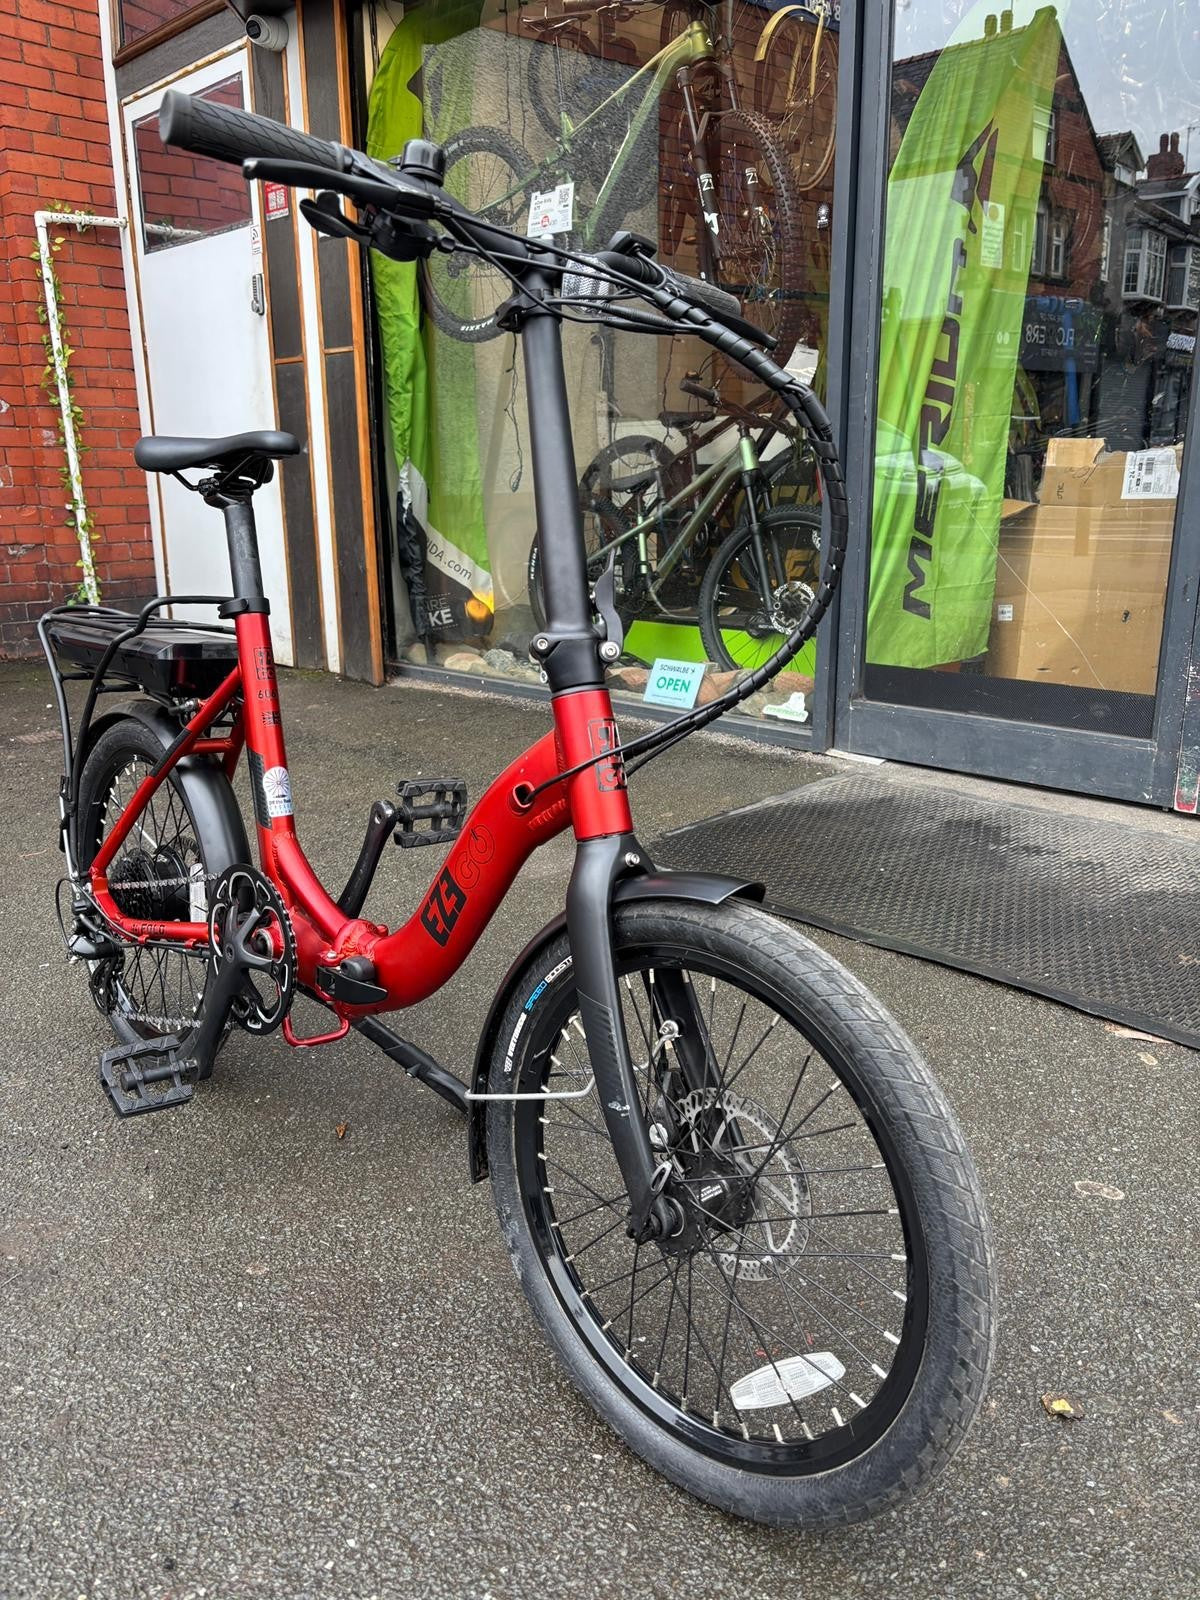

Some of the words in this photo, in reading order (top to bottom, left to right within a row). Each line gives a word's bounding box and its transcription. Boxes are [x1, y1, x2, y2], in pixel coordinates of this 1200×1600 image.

[700, 178, 715, 191] Z1
[745, 172, 759, 185] Z1
[427, 537, 472, 580] IDA.com
[530, 547, 538, 580] KENDA
[428, 608, 454, 627] KE
[660, 664, 690, 673] SCHWALBE
[657, 676, 691, 693] OPEN
